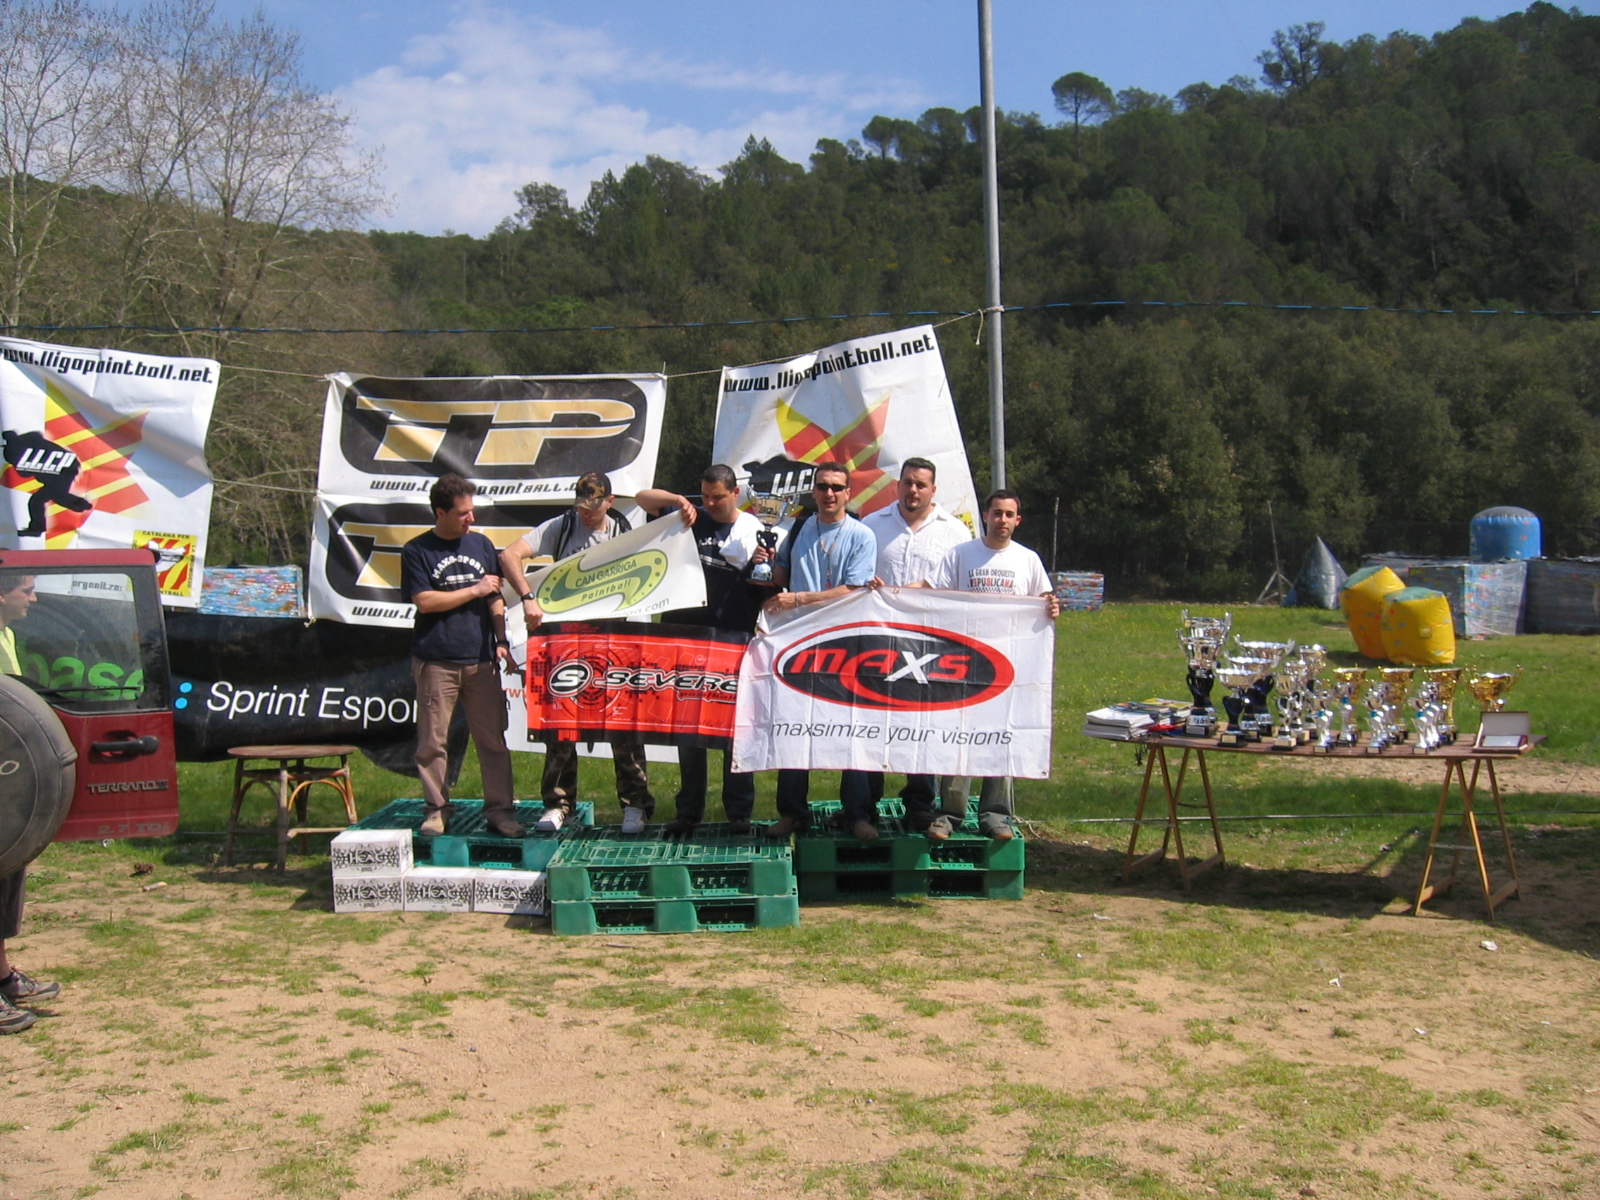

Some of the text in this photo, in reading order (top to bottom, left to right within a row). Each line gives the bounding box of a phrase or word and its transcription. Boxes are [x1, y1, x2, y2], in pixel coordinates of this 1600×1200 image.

[16, 447, 77, 472] LLCP
[596, 559, 637, 581] GARRIGA
[581, 578, 632, 602] Paintball
[789, 648, 972, 685] MAXS
[206, 681, 310, 720] Sprint
[770, 719, 1013, 745] maxsimize your visions
[87, 780, 158, 794] TERRANO
